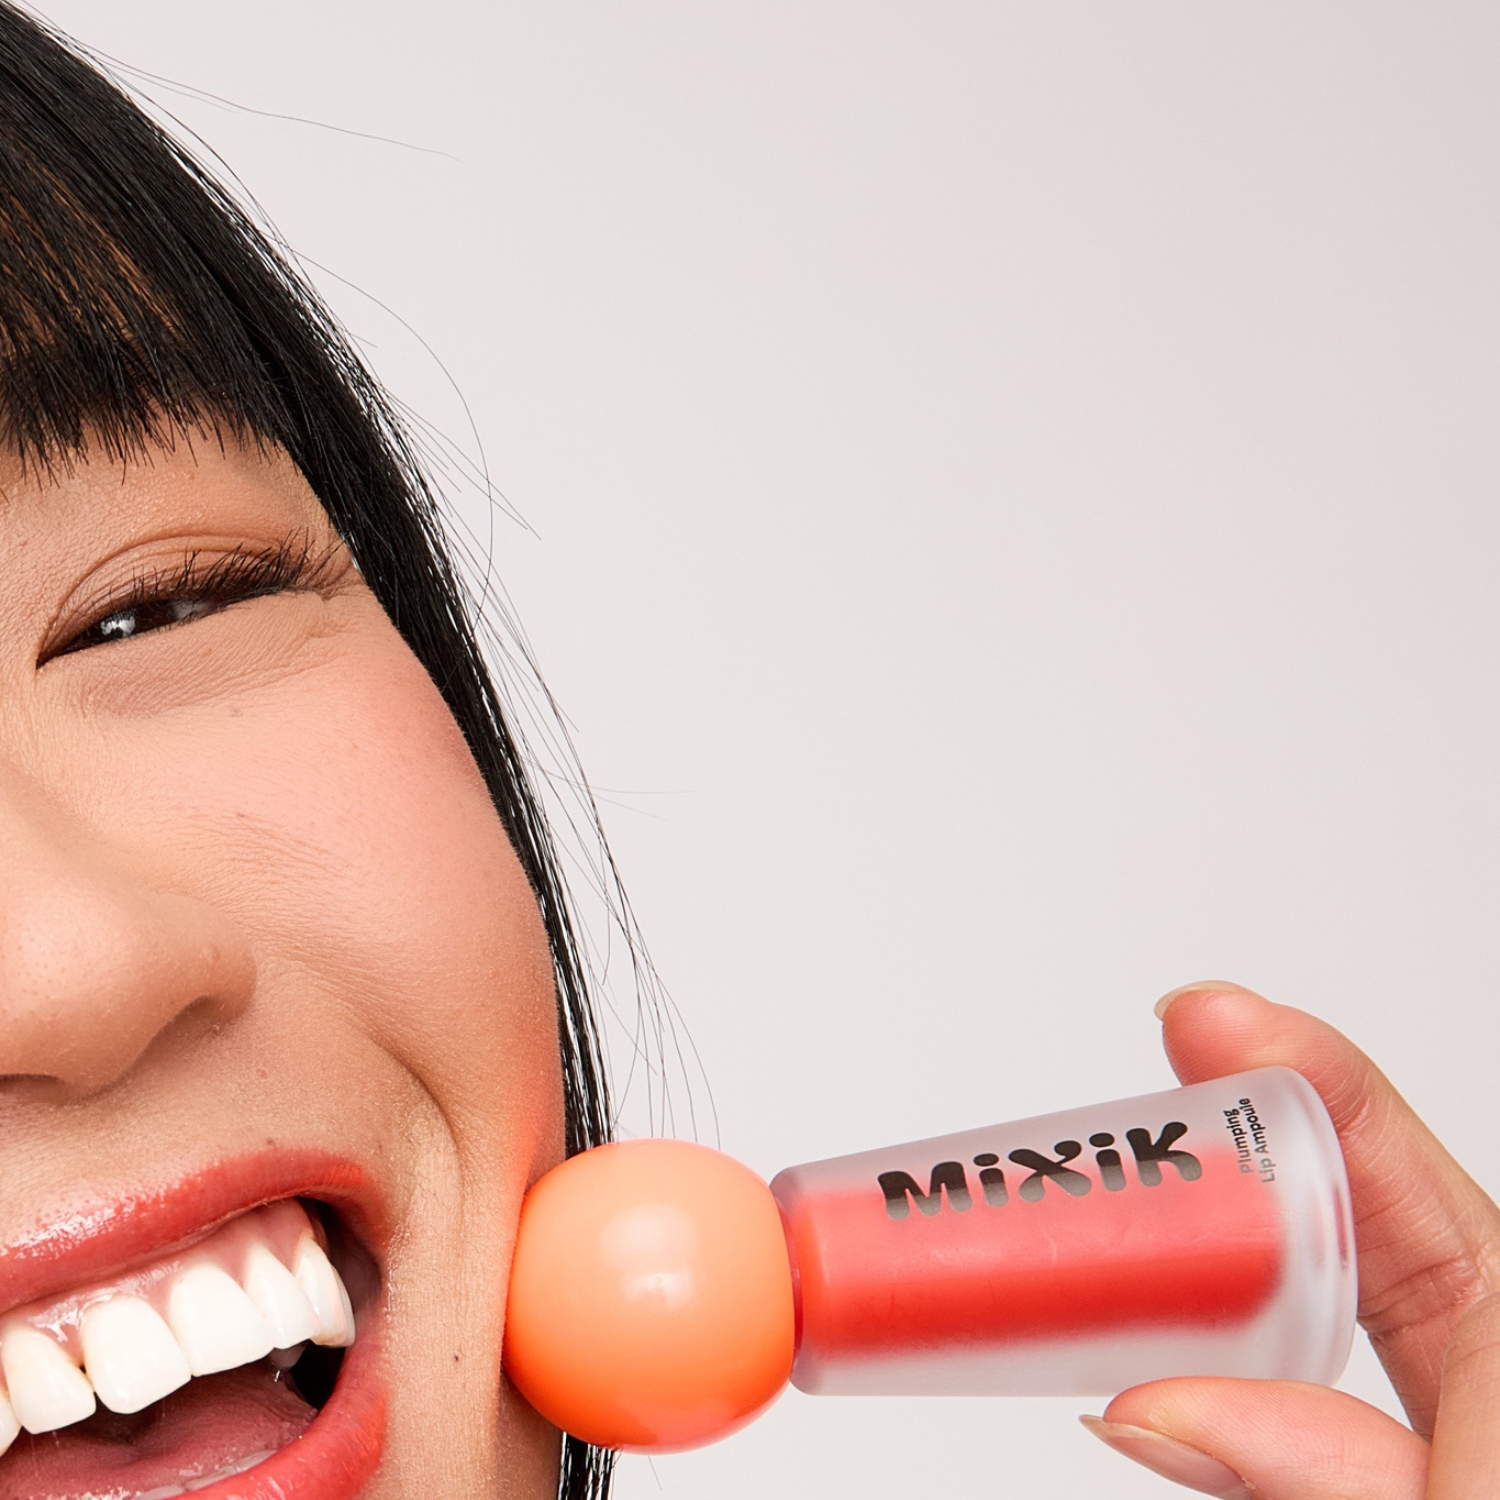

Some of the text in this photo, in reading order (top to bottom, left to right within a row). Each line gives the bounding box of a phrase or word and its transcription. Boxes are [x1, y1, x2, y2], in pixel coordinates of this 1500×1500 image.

[1223, 1108, 1254, 1174] Plumping
[1238, 1097, 1276, 1182] Lip Ampoule
